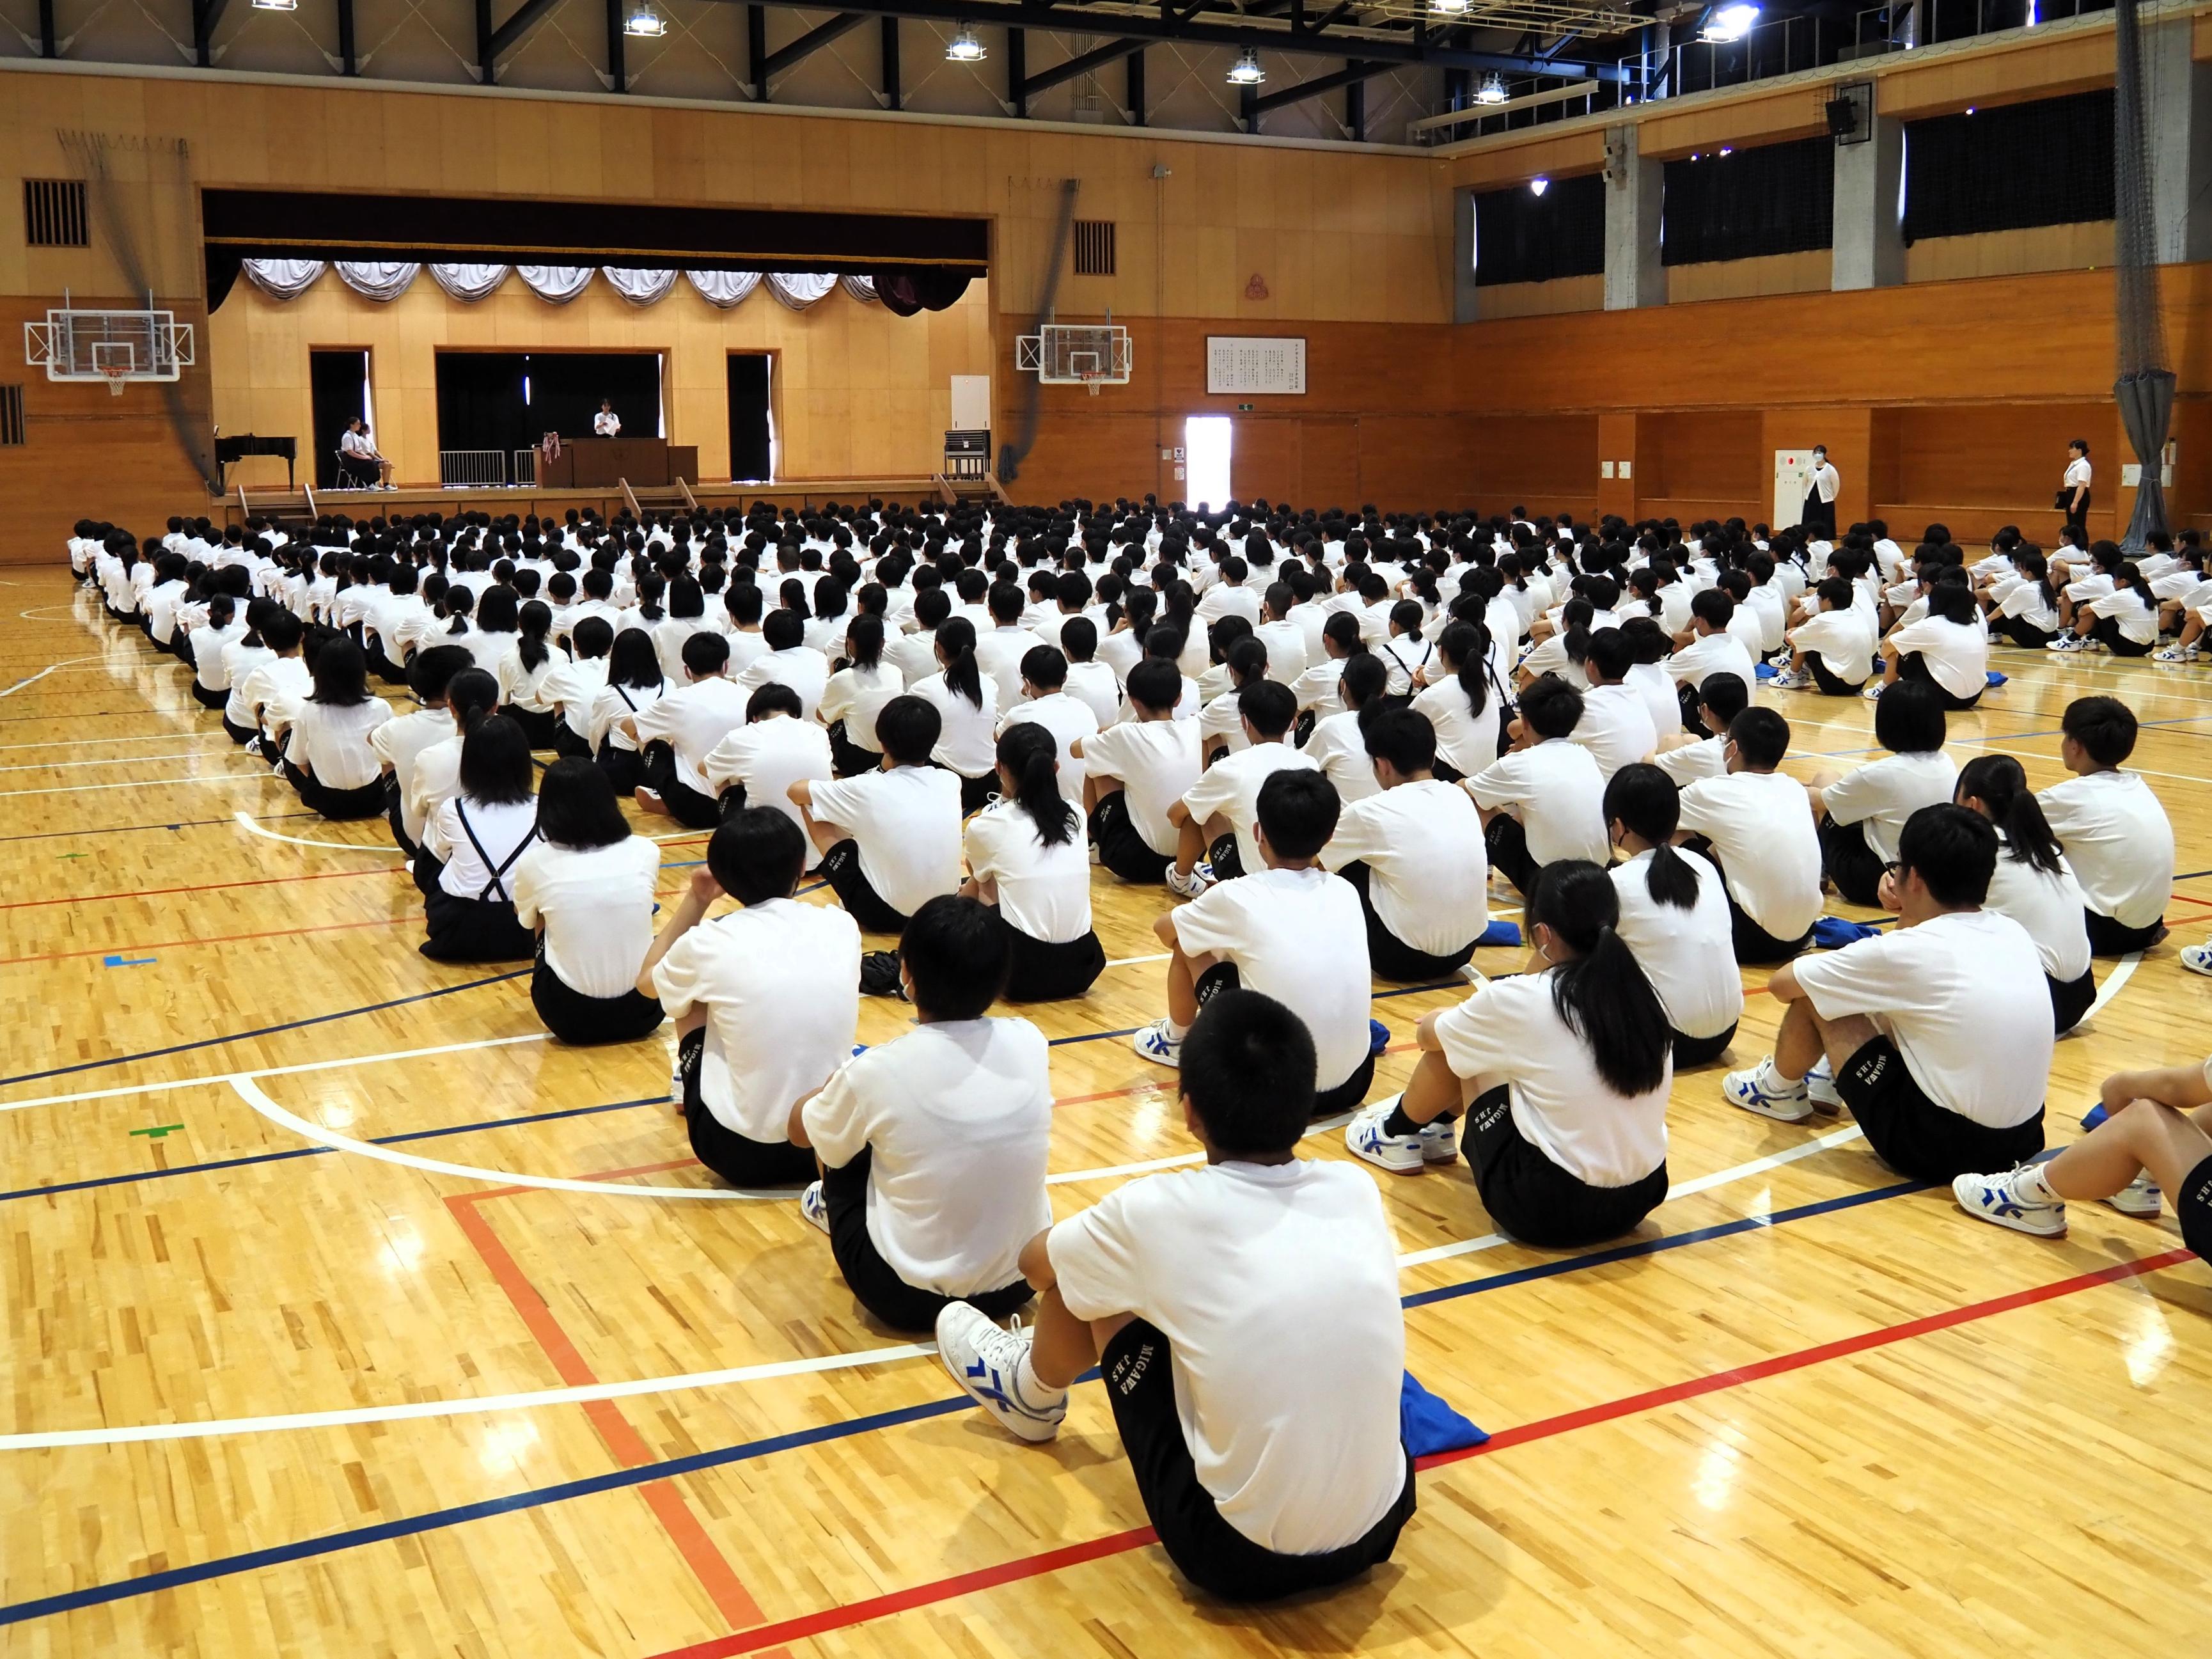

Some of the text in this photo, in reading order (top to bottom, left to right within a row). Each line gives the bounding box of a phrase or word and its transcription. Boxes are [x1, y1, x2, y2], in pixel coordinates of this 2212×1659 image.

[1208, 979, 1223, 1002] MIGA
[1864, 1054, 1886, 1085] MIGAWA
[1479, 1103, 1508, 1132] MIGAWA
[1120, 1344, 1154, 1396] MIGAWA
